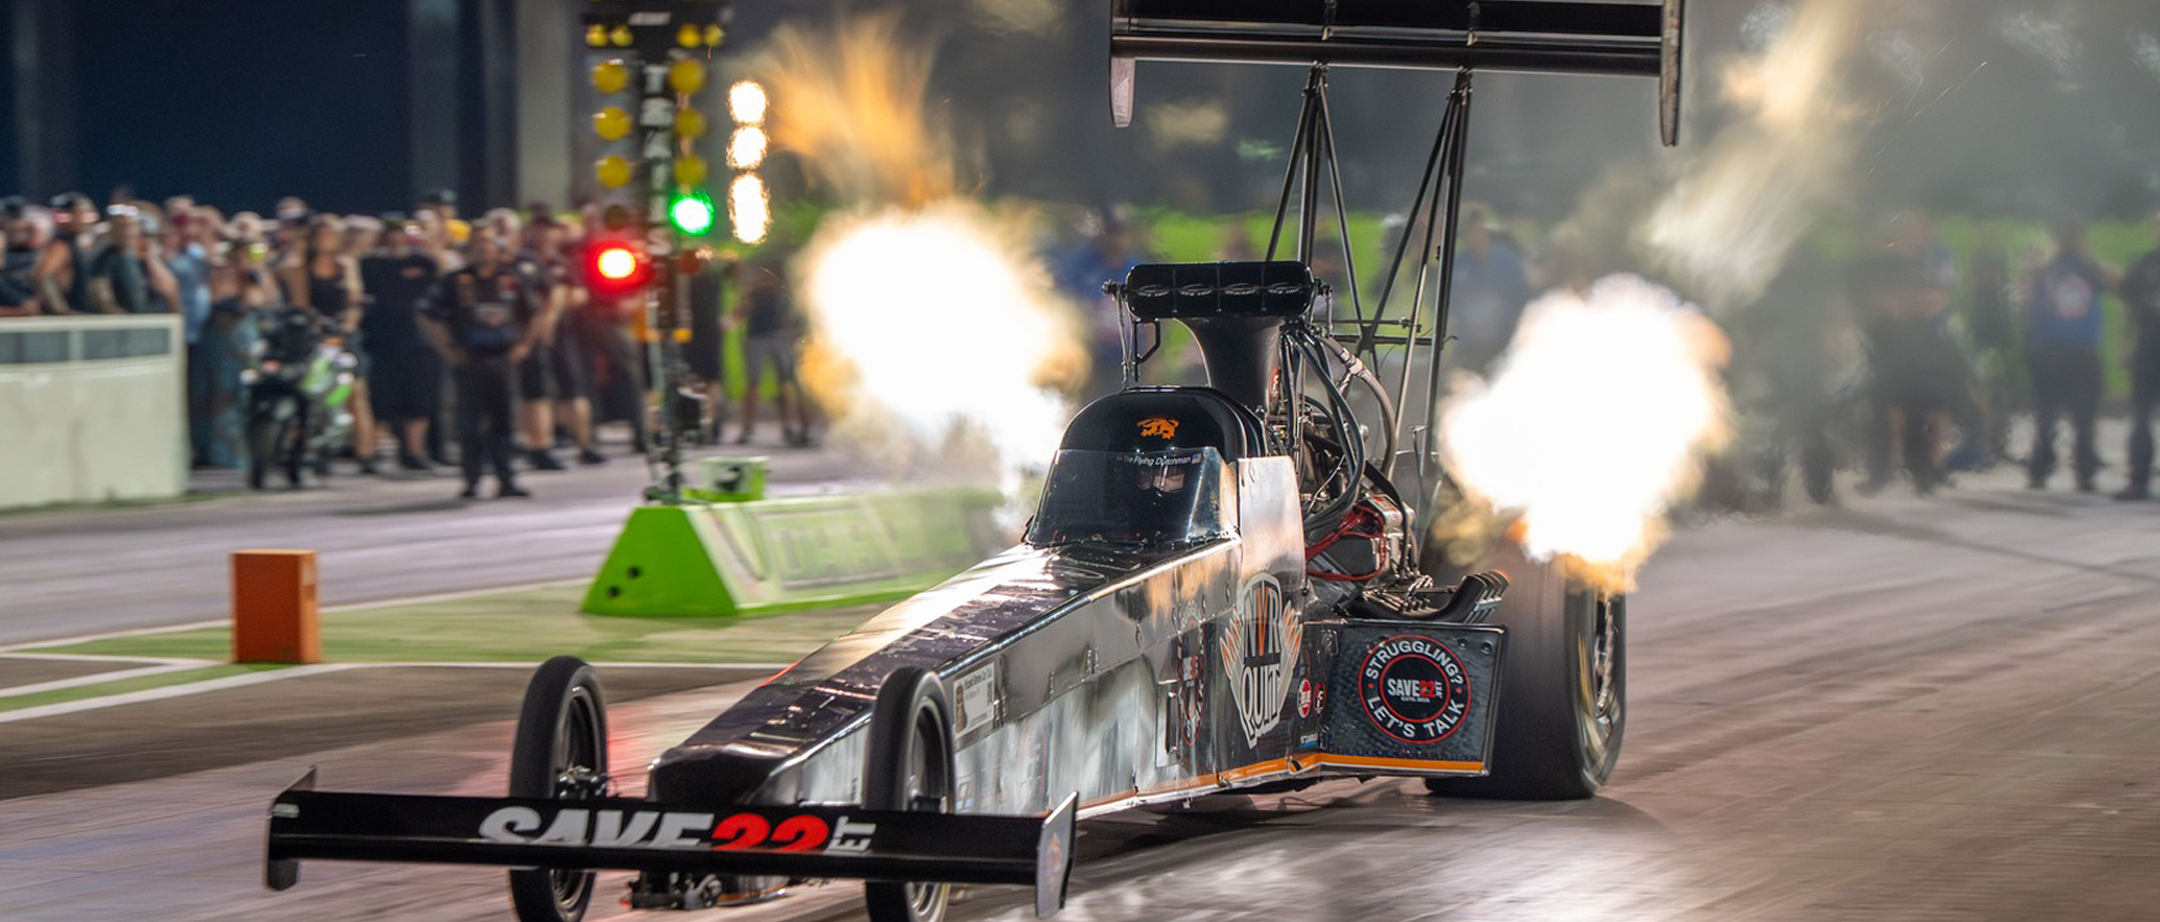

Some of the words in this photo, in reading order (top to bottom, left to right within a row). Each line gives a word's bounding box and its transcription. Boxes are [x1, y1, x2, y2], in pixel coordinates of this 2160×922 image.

[1366, 640, 1464, 684] STRUGGLING?
[1242, 664, 1280, 741] QUIT
[1367, 696, 1416, 738] LET'S
[1423, 699, 1465, 737] TALK
